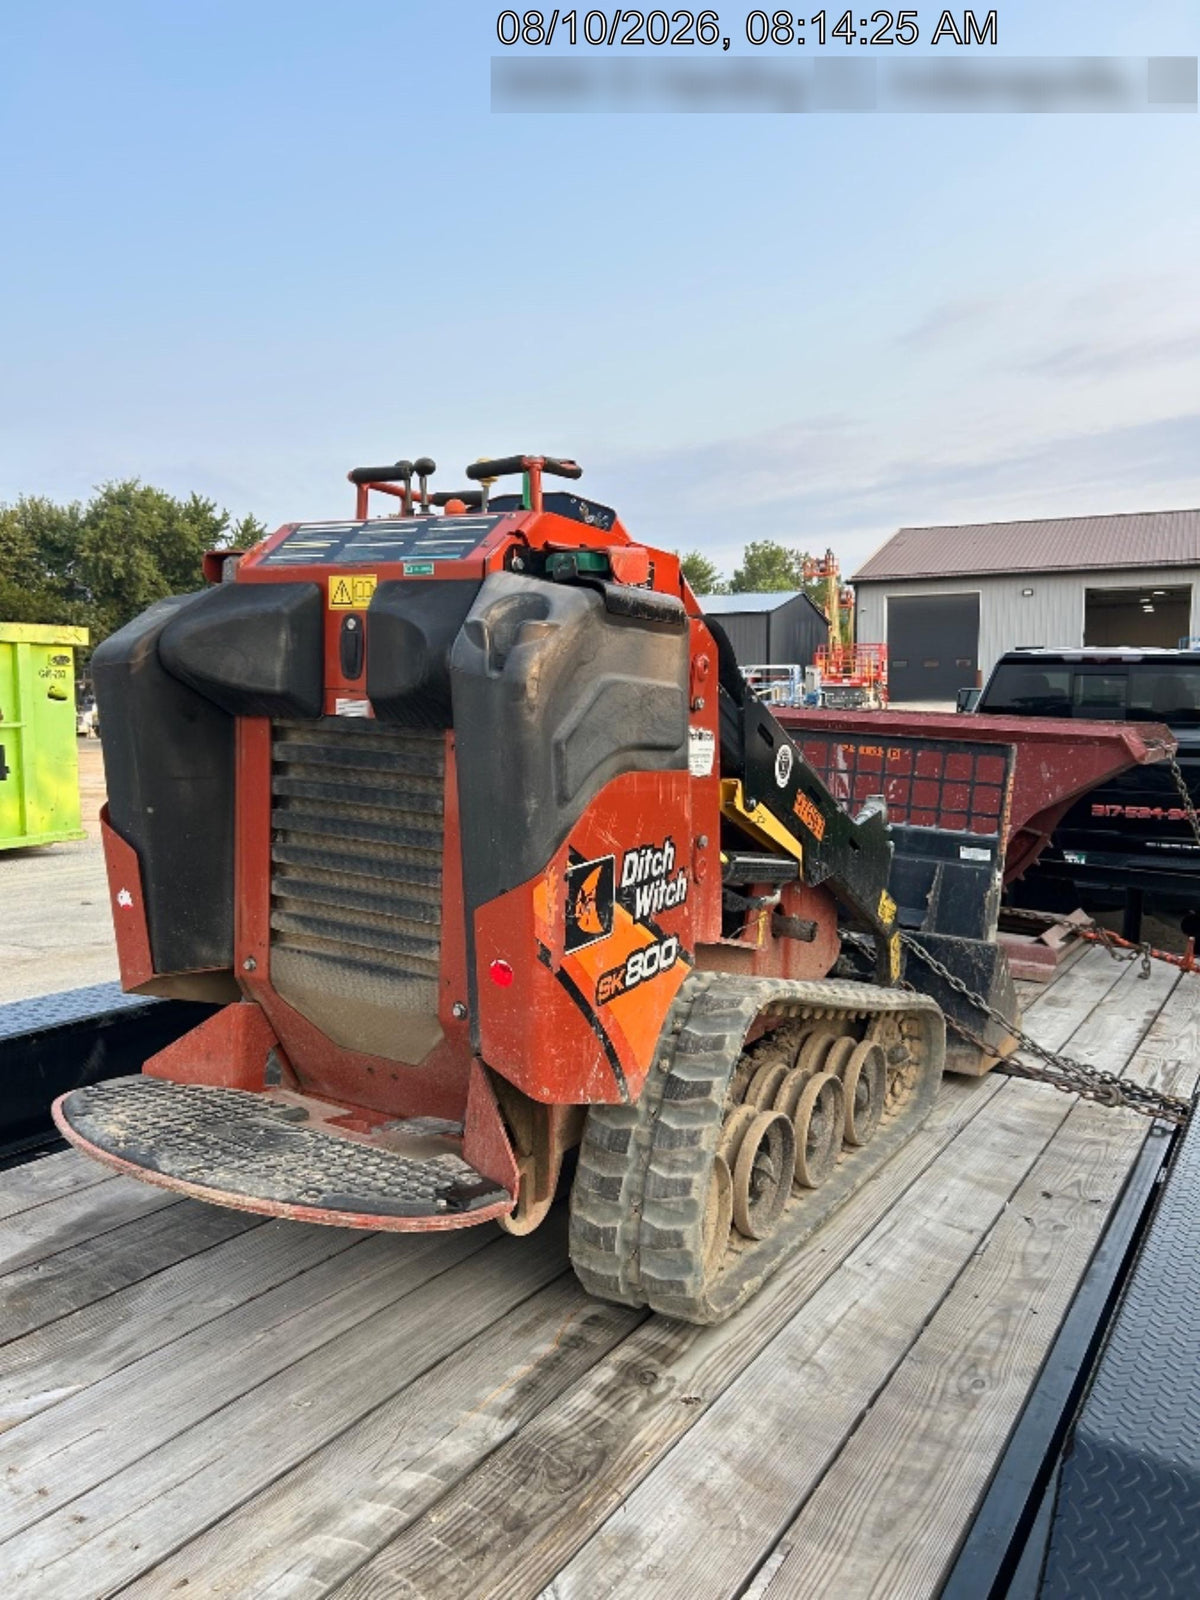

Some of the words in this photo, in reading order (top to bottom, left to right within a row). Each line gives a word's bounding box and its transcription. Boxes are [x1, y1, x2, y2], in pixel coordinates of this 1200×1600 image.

[620, 838, 676, 888] Ditch
[634, 869, 688, 920] Witch
[597, 936, 679, 1003] SK800
